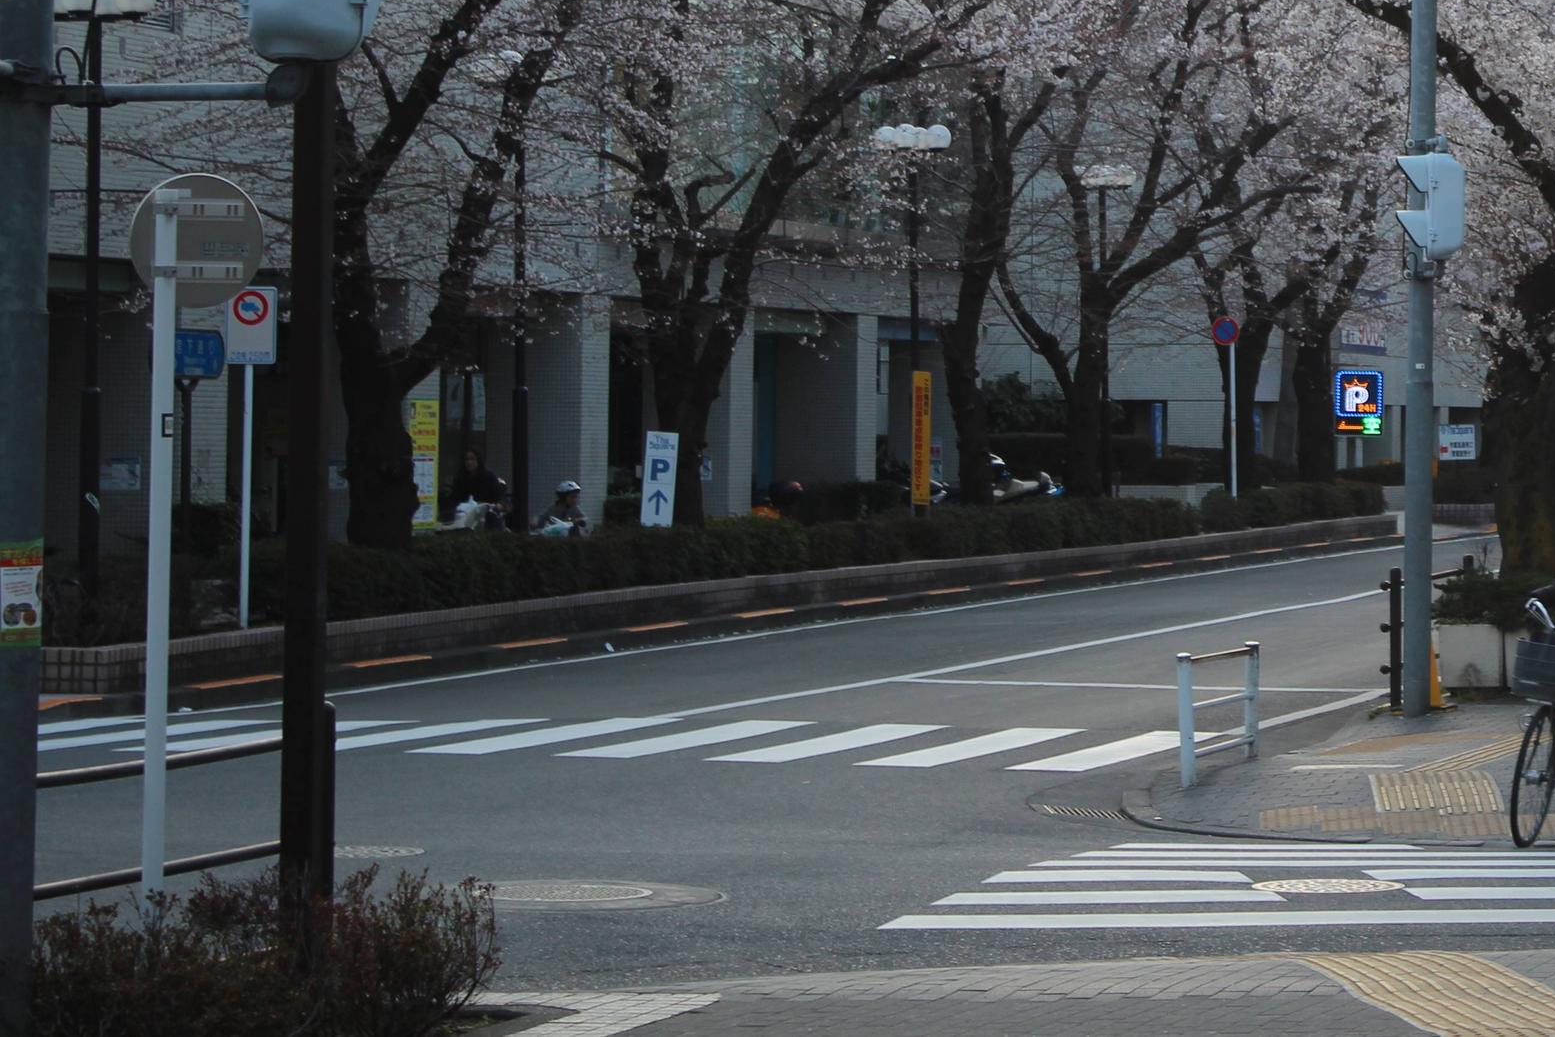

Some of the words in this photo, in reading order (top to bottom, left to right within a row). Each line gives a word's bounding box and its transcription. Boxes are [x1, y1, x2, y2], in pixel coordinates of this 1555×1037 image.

[1345, 386, 1369, 412] P
[1357, 403, 1377, 413] 24H
[650, 458, 670, 481] P
